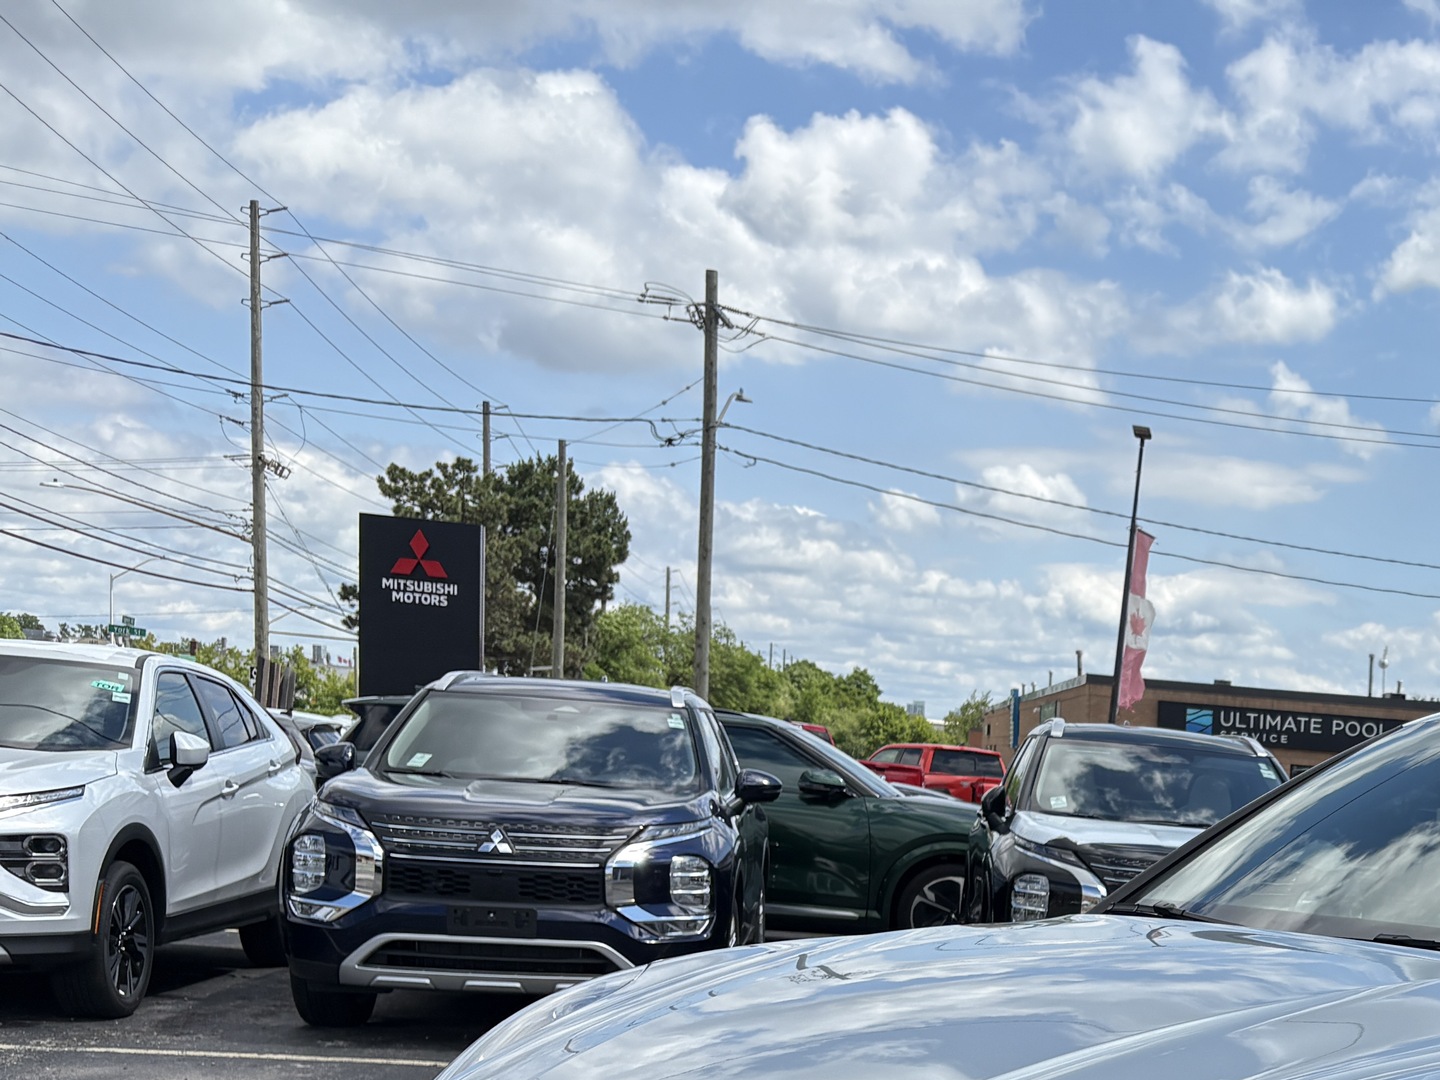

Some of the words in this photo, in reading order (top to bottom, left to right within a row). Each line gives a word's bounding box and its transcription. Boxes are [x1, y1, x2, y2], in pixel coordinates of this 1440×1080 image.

[381, 577, 458, 596] MITSUBISHI
[391, 590, 448, 607] MOTORS
[1219, 710, 1323, 734] ULTIMATE
